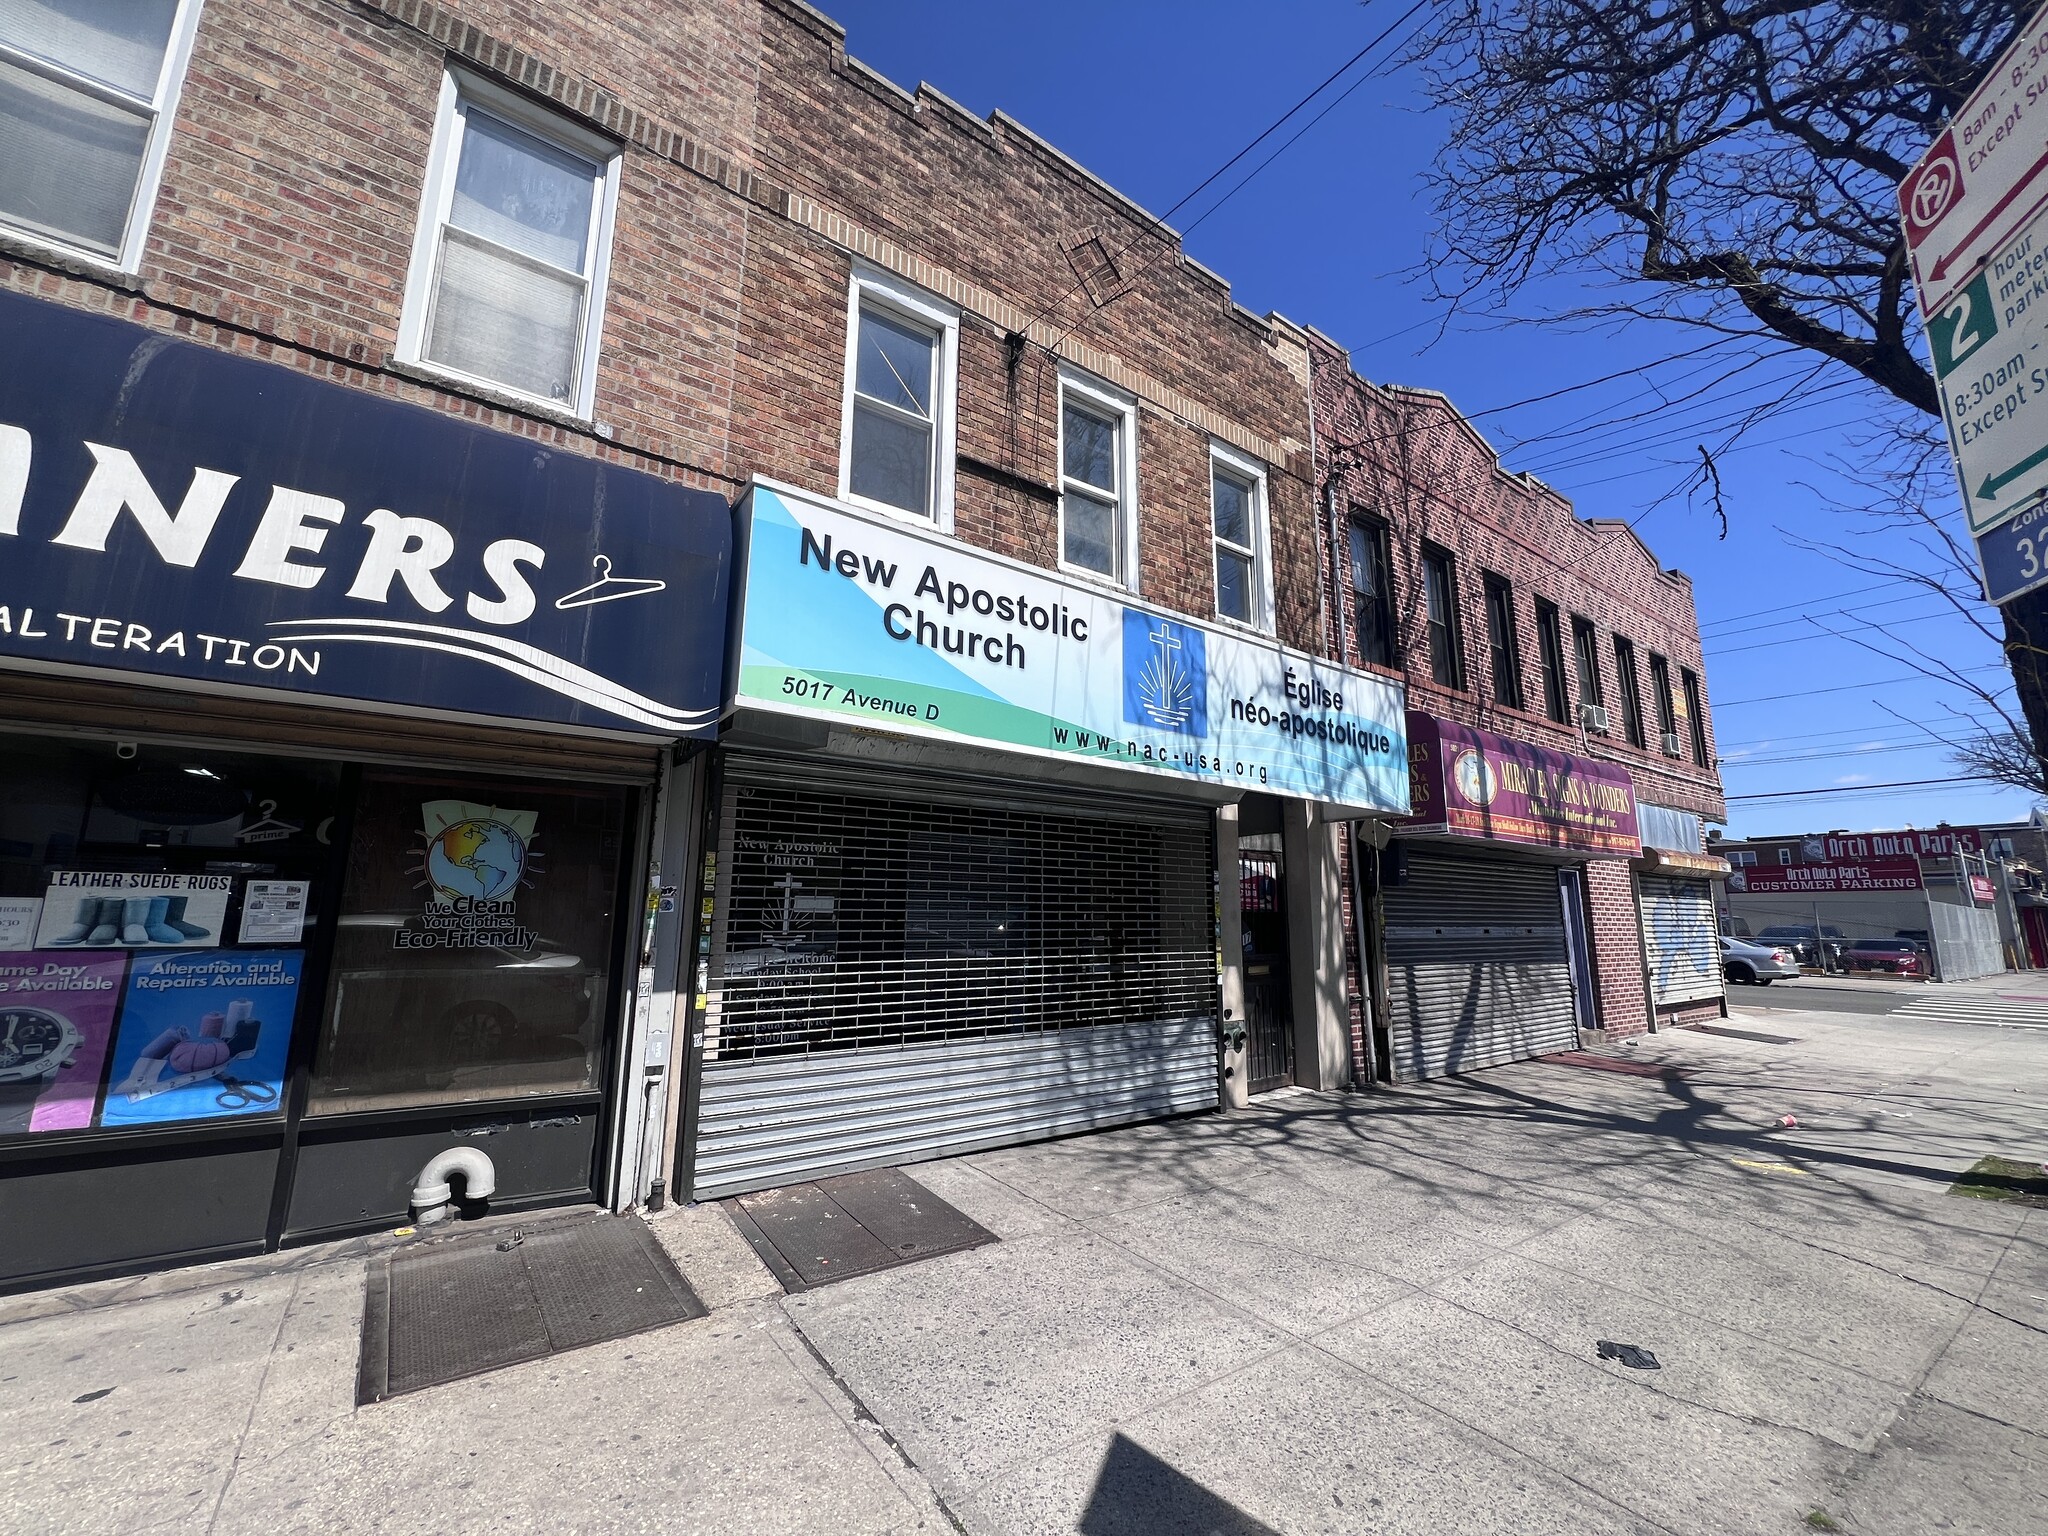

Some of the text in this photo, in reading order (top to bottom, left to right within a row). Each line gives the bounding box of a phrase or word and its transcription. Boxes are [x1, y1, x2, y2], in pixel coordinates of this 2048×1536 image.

[1964, 101, 1997, 145] 8am
[1967, 103, 2022, 172] Except
[1994, 234, 2032, 280] hour
[1943, 292, 1979, 361] 2
[1954, 354, 2025, 417] 8:30am
[1960, 384, 2027, 446] Except
[800, 527, 1088, 641] New Apostolic
[883, 603, 1025, 669] Church
[782, 676, 939, 720] 5017 Avenue D
[1284, 667, 1343, 711] Église
[1231, 696, 1390, 754] néo-apostolique
[1054, 727, 1268, 784] www.nac-usa.org
[1553, 773, 1581, 807] SIGNS
[1583, 781, 1590, 808] &
[1589, 781, 1631, 815] WONDERS
[250, 831, 284, 842] prime
[738, 836, 840, 854] New Apostolic
[1828, 831, 1974, 858] Arch Auto Parts
[763, 853, 815, 866] Church
[1786, 865, 1869, 880] Arch Auto Parts
[50, 872, 229, 890] LEATHER SUEDE RUGS
[1751, 878, 1917, 892] CUSTOMER PARKING
[425, 894, 516, 915] We Clean
[0, 919, 20, 927] :30
[422, 914, 515, 929] Your Clothes
[393, 926, 538, 952] Eco-Friendly
[42, 963, 89, 978] Day
[150, 960, 283, 976] Alteration and
[15, 977, 113, 991] Available
[136, 972, 295, 991] Repairs Available
